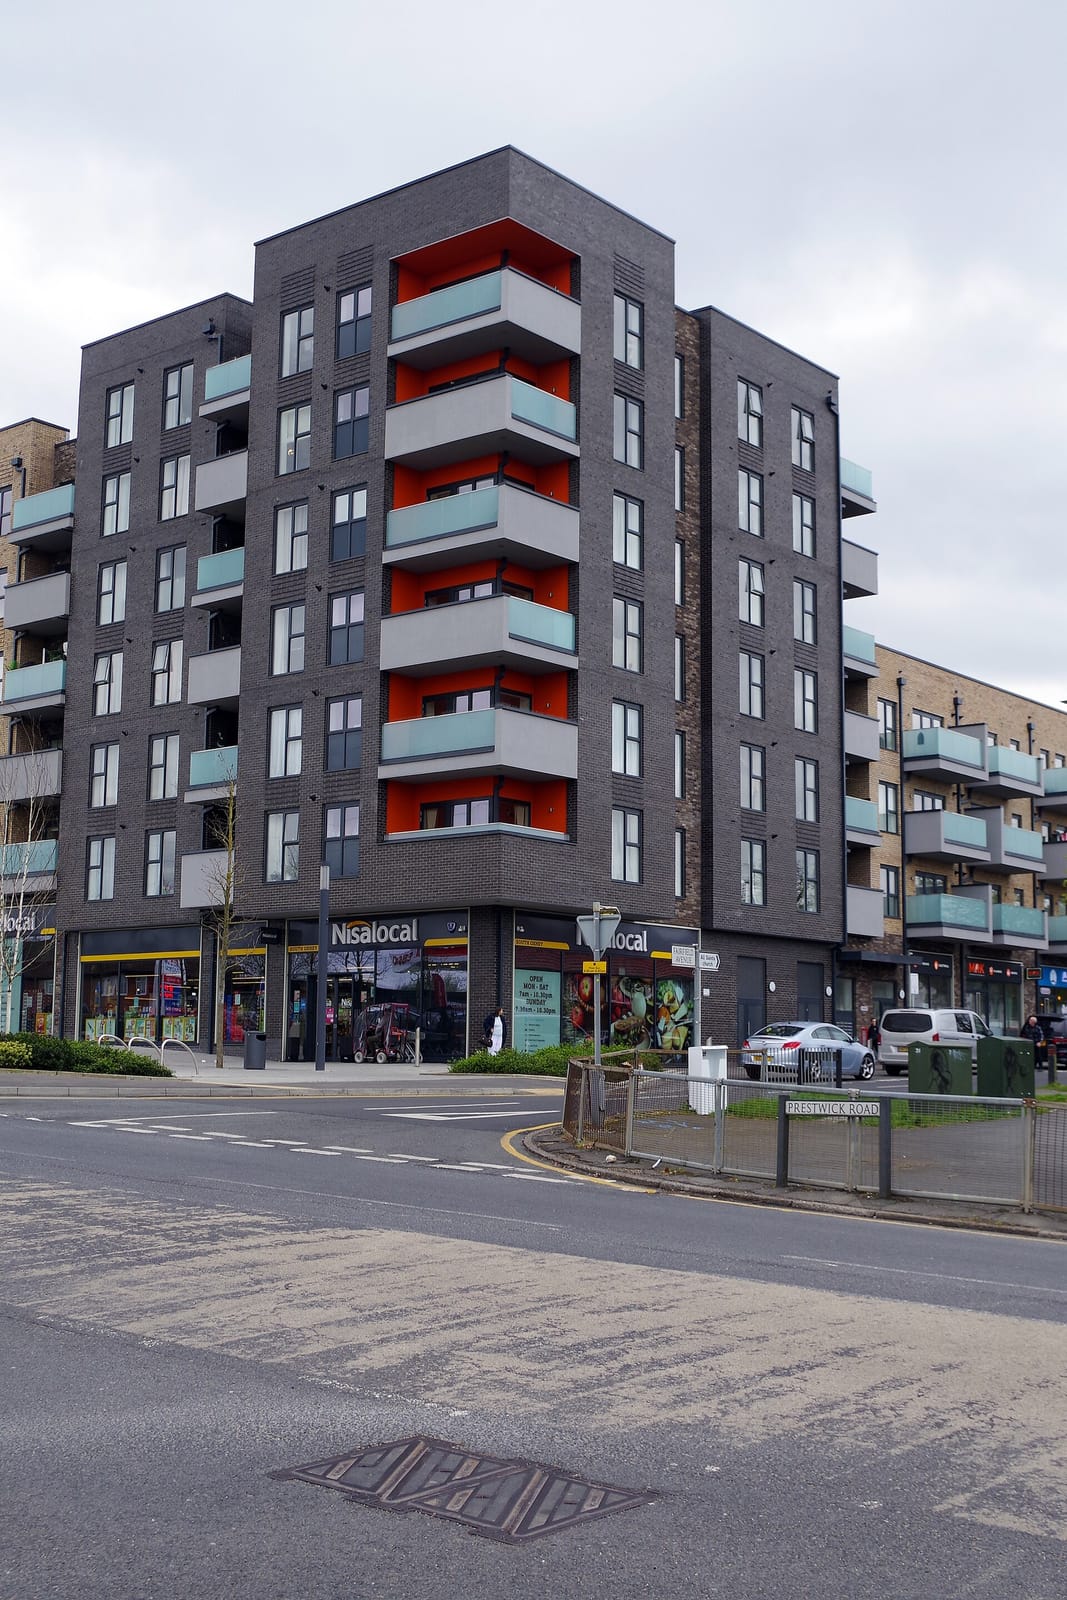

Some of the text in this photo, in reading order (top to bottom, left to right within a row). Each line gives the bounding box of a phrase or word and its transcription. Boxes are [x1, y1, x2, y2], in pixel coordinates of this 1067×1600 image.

[332, 919, 419, 945] Nisalocal
[788, 1102, 879, 1115] PRESTWICK ROAD
